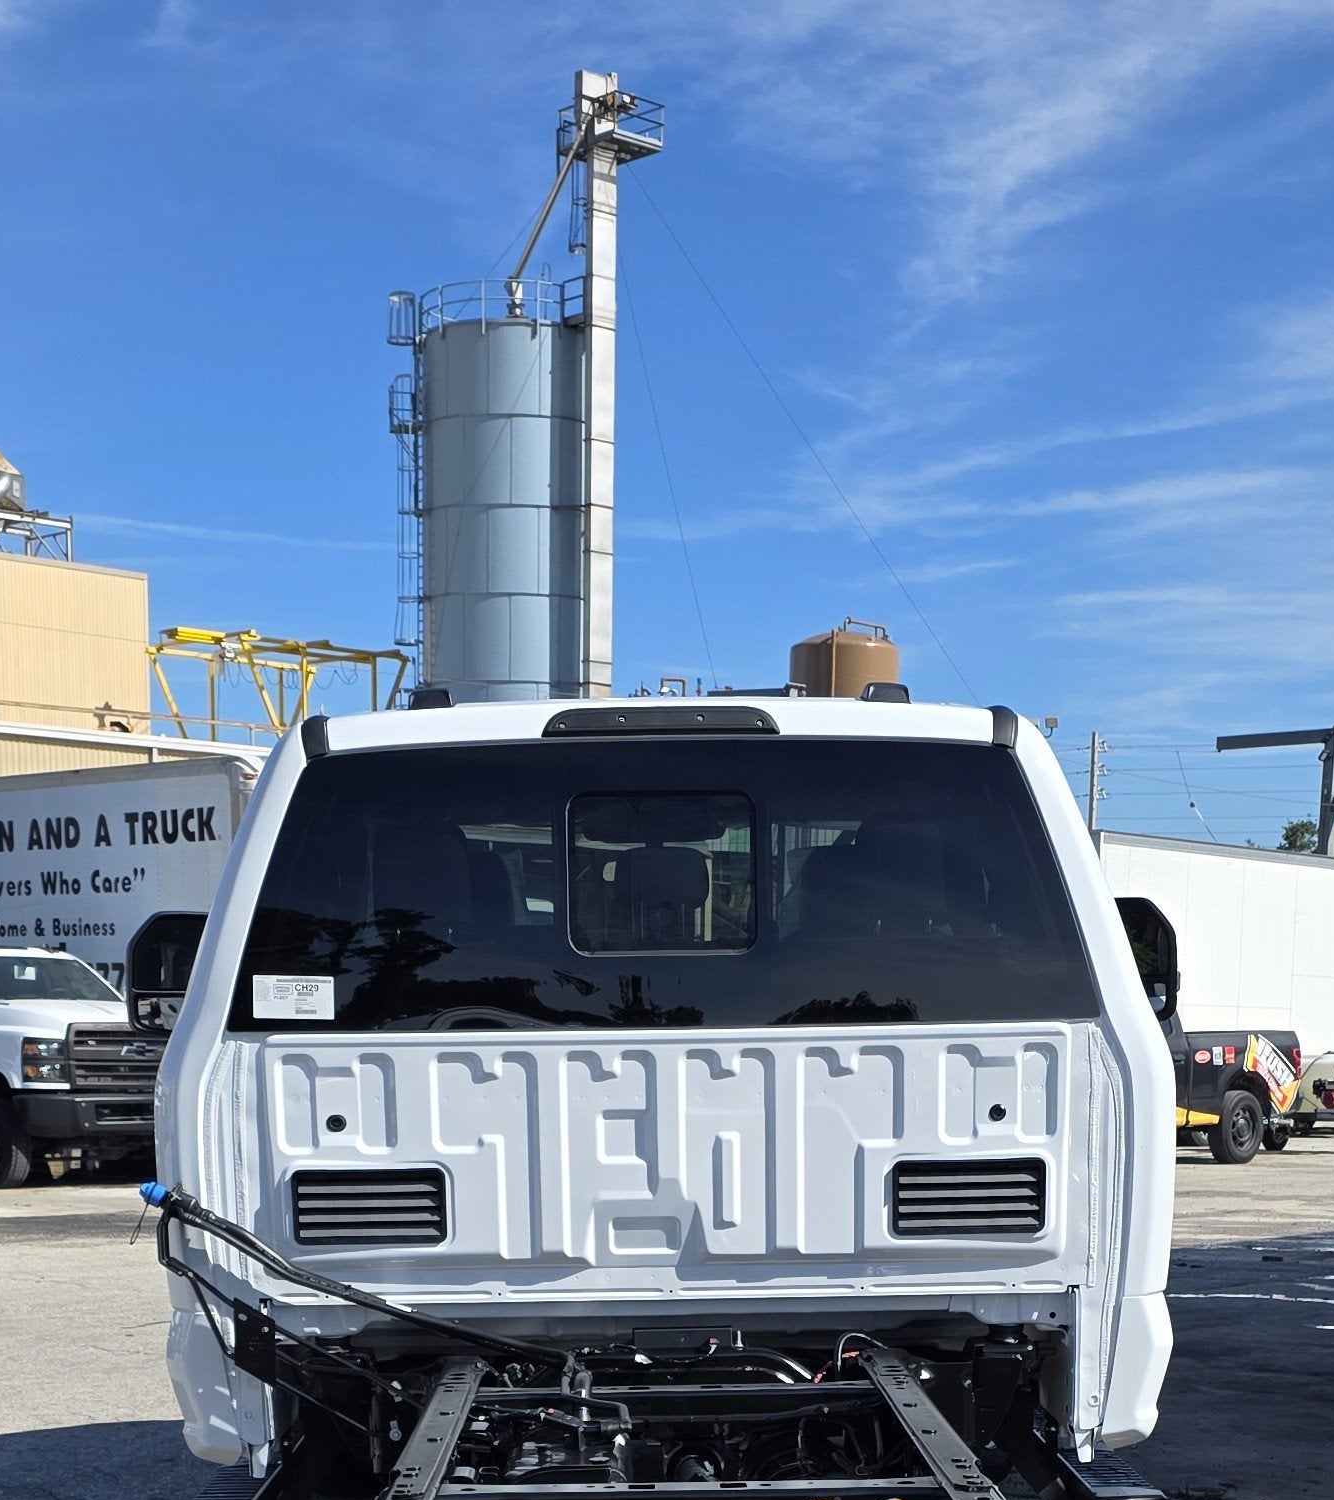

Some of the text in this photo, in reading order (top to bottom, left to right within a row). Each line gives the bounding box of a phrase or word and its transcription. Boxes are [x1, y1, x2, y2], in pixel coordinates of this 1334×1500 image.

[27, 816, 80, 851] AND
[94, 813, 112, 847] A
[40, 871, 81, 896] Who
[34, 917, 46, 937] &
[53, 917, 116, 937] Business
